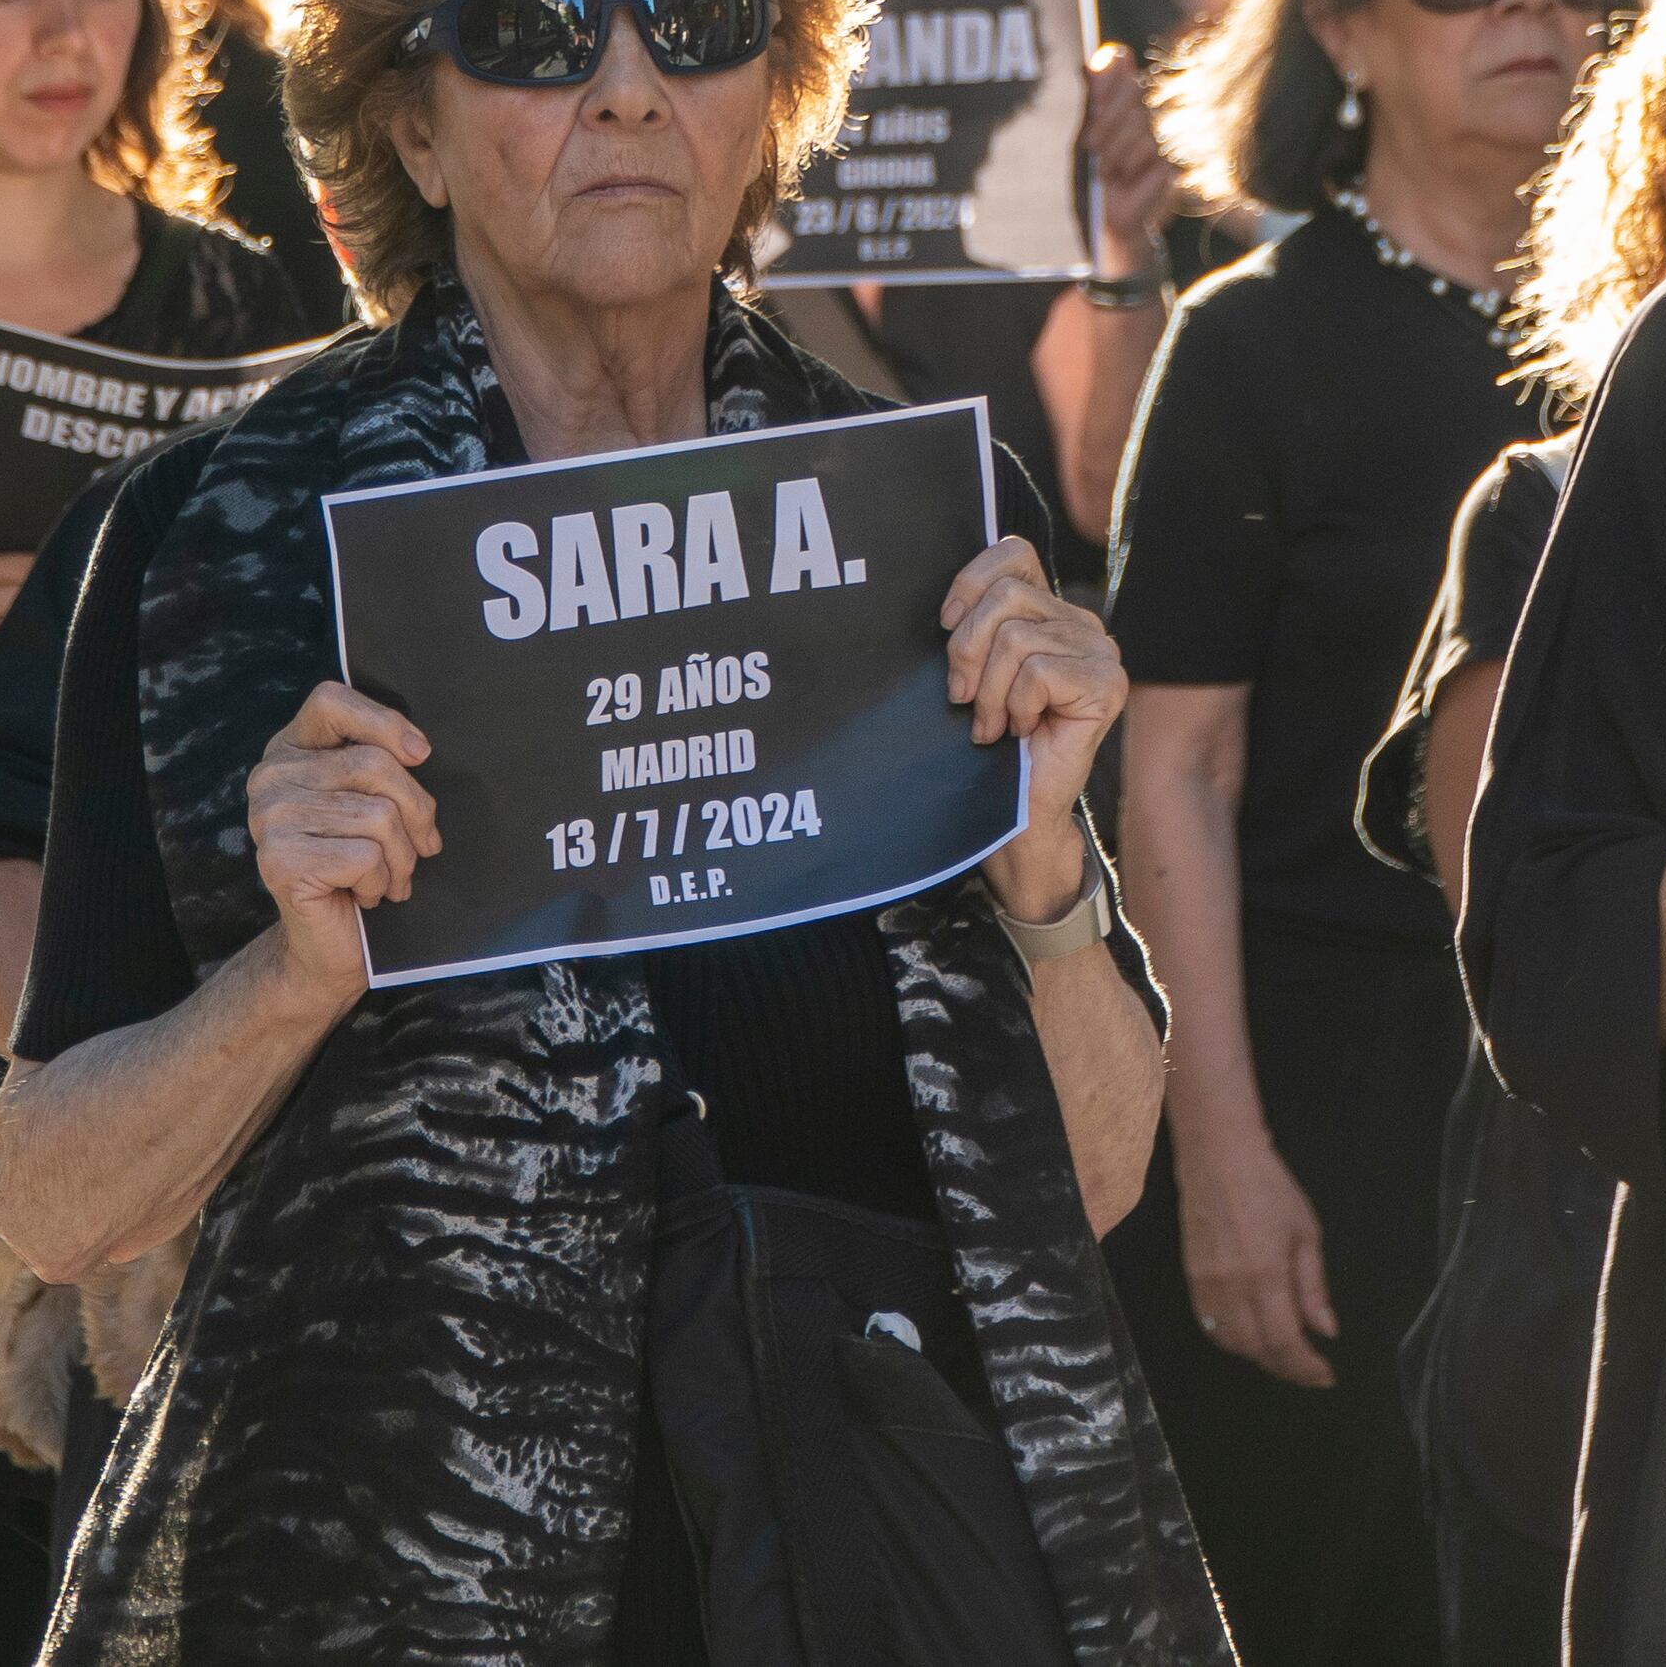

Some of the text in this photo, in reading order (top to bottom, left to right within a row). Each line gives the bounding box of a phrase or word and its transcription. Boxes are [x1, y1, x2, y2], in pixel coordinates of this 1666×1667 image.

[850, 6, 1039, 88] ANDA
[153, 385, 183, 421] Y
[475, 477, 868, 641] SARA A.
[586, 651, 772, 727] 29 AÑOS
[601, 729, 757, 793] MADRID
[650, 869, 734, 907] D.E.P.
